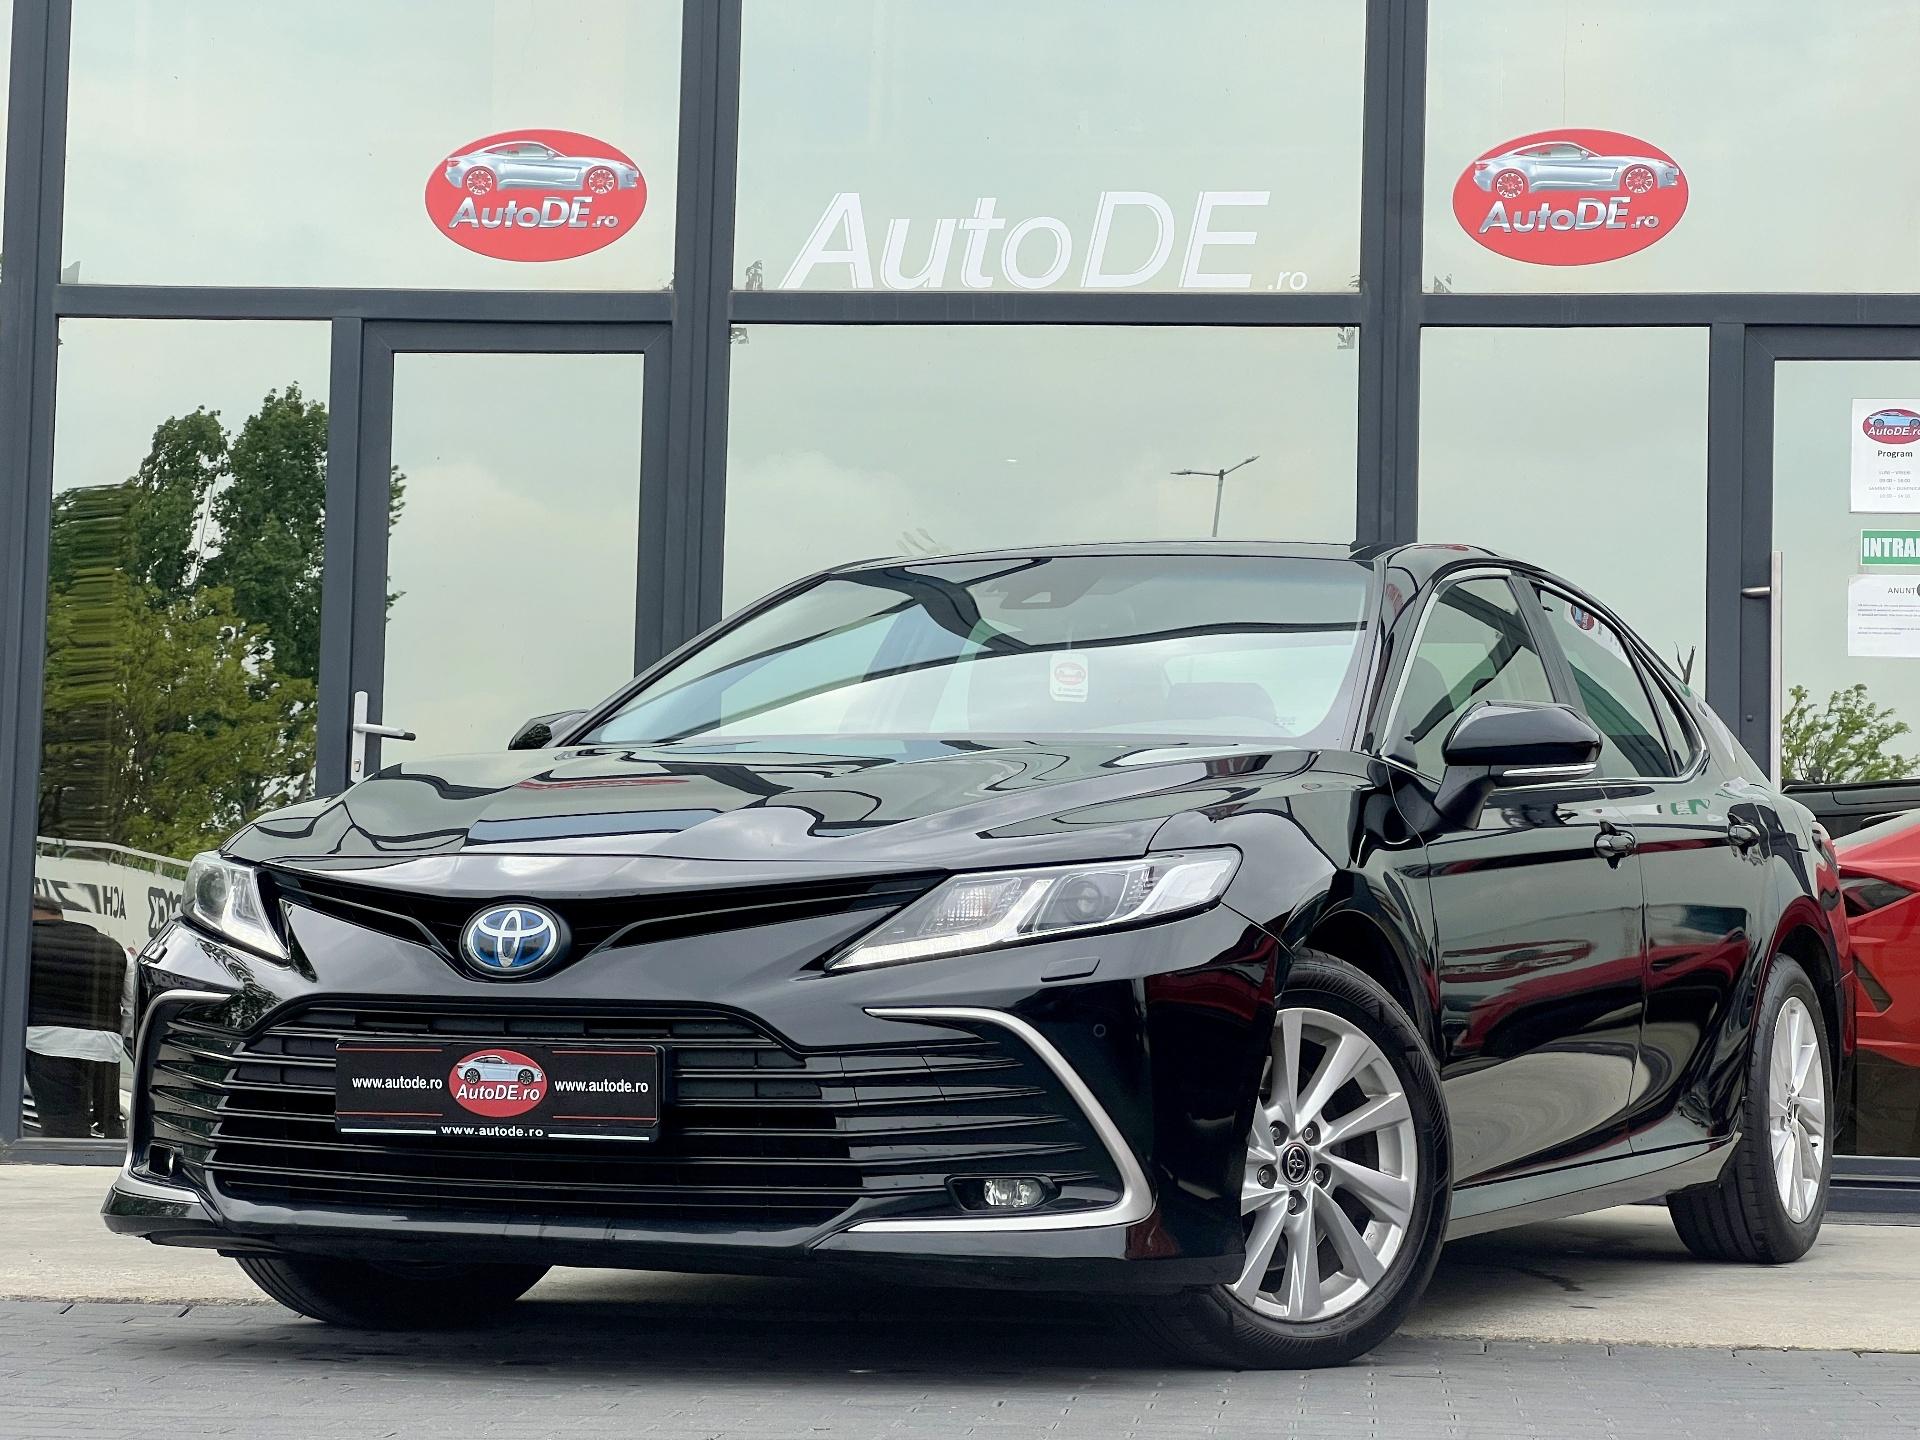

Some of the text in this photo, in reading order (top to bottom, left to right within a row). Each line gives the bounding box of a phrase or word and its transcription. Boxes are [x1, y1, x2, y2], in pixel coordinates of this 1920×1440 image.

[1877, 450, 1913, 458] Program
[351, 1075, 443, 1090] www.autode.ro
[554, 1080, 650, 1094] www.autode.ro
[455, 1083, 541, 1101] AutoDE.ro
[440, 1125, 544, 1138] www.autode.ro
